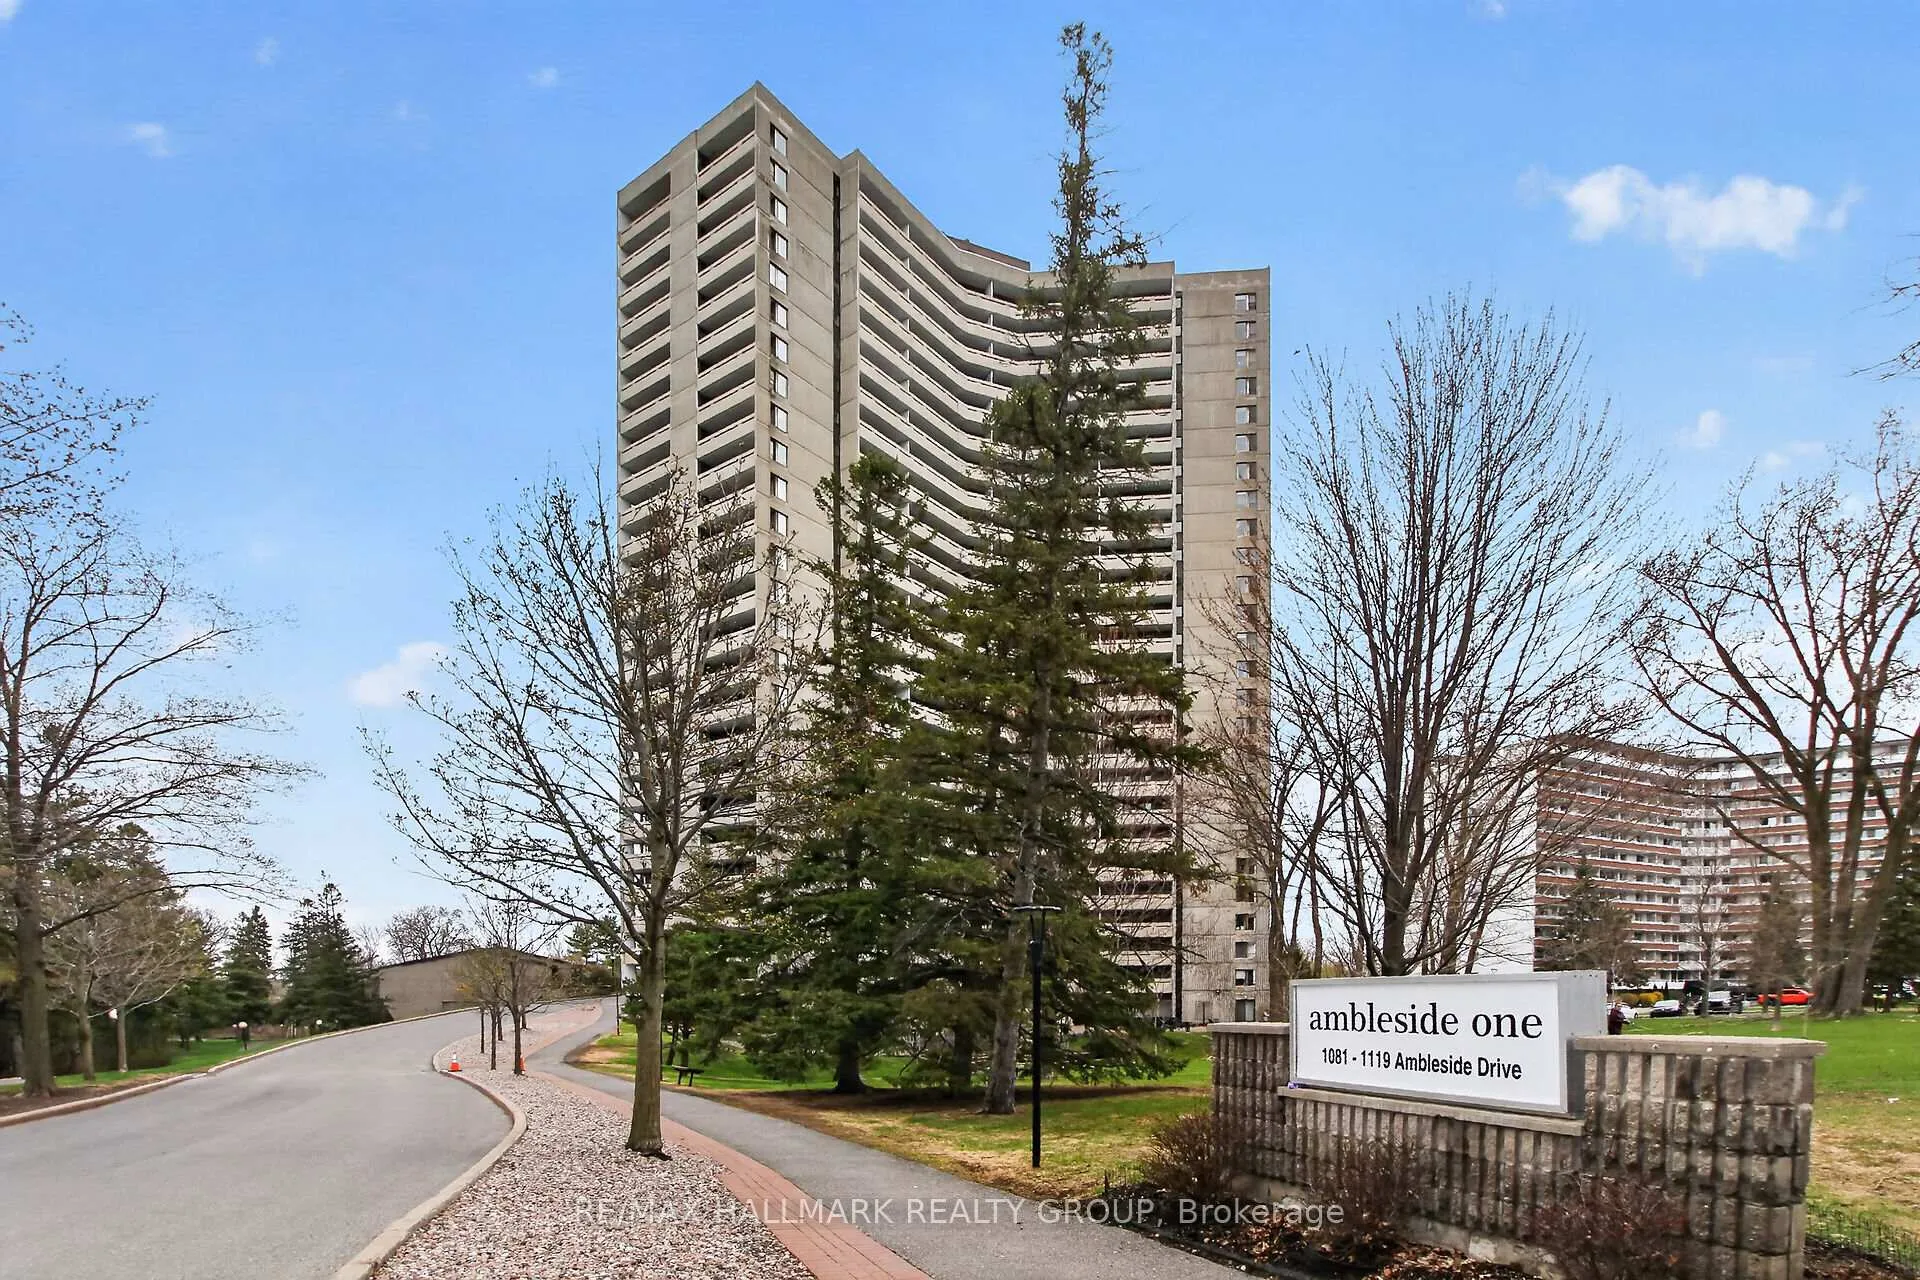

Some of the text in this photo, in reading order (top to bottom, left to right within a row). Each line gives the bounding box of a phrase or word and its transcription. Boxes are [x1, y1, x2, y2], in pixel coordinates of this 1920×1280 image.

[1309, 1002, 1543, 1039] ambleside one
[1321, 1047, 1348, 1065] 1081
[1360, 1050, 1391, 1069] 1119
[1394, 1052, 1473, 1076] Ambleside
[1477, 1057, 1522, 1080] Drive
